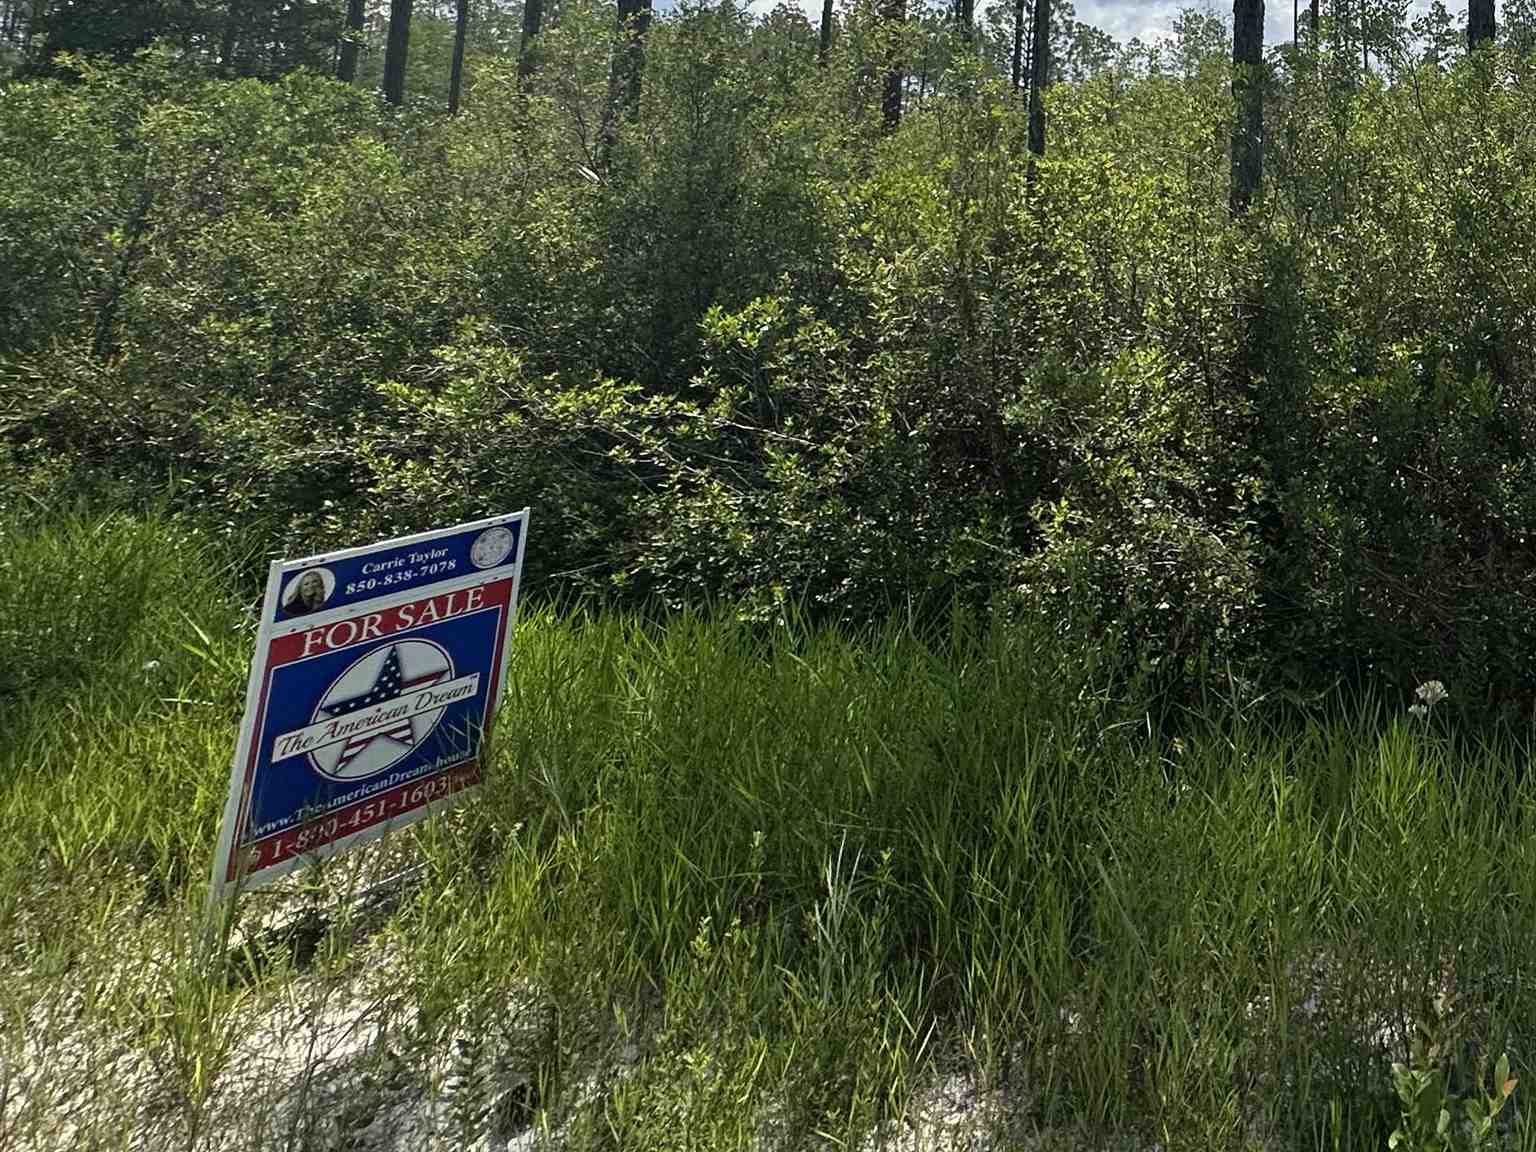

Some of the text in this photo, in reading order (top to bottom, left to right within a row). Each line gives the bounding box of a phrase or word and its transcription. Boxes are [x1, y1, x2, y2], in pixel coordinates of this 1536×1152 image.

[345, 559, 457, 595] 850-838-7078
[361, 548, 449, 575] Carrie Taylor
[301, 586, 486, 658] FOR SALE
[278, 683, 474, 757] The American Dream
